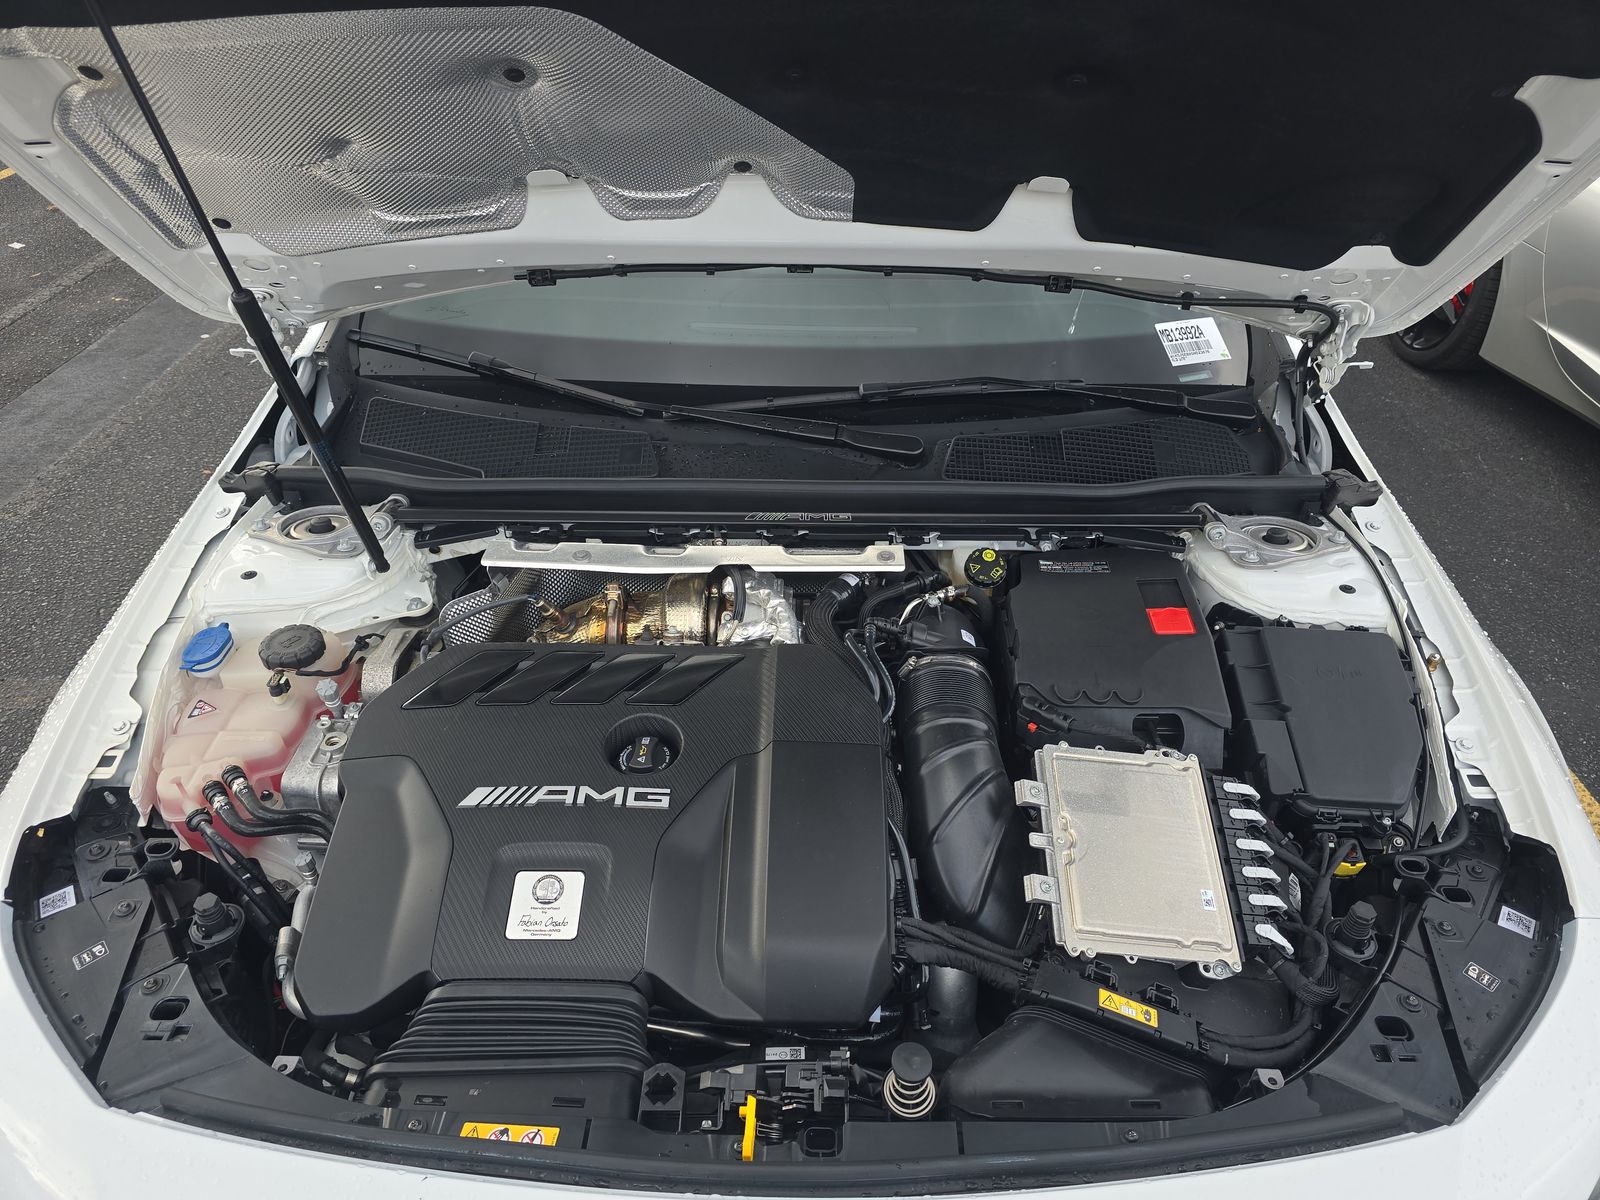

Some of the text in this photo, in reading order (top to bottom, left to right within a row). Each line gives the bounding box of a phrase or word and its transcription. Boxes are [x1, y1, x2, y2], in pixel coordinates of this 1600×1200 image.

[1158, 325, 1206, 343] MB13992A
[779, 512, 852, 521] AMG
[523, 786, 671, 809] AMG
